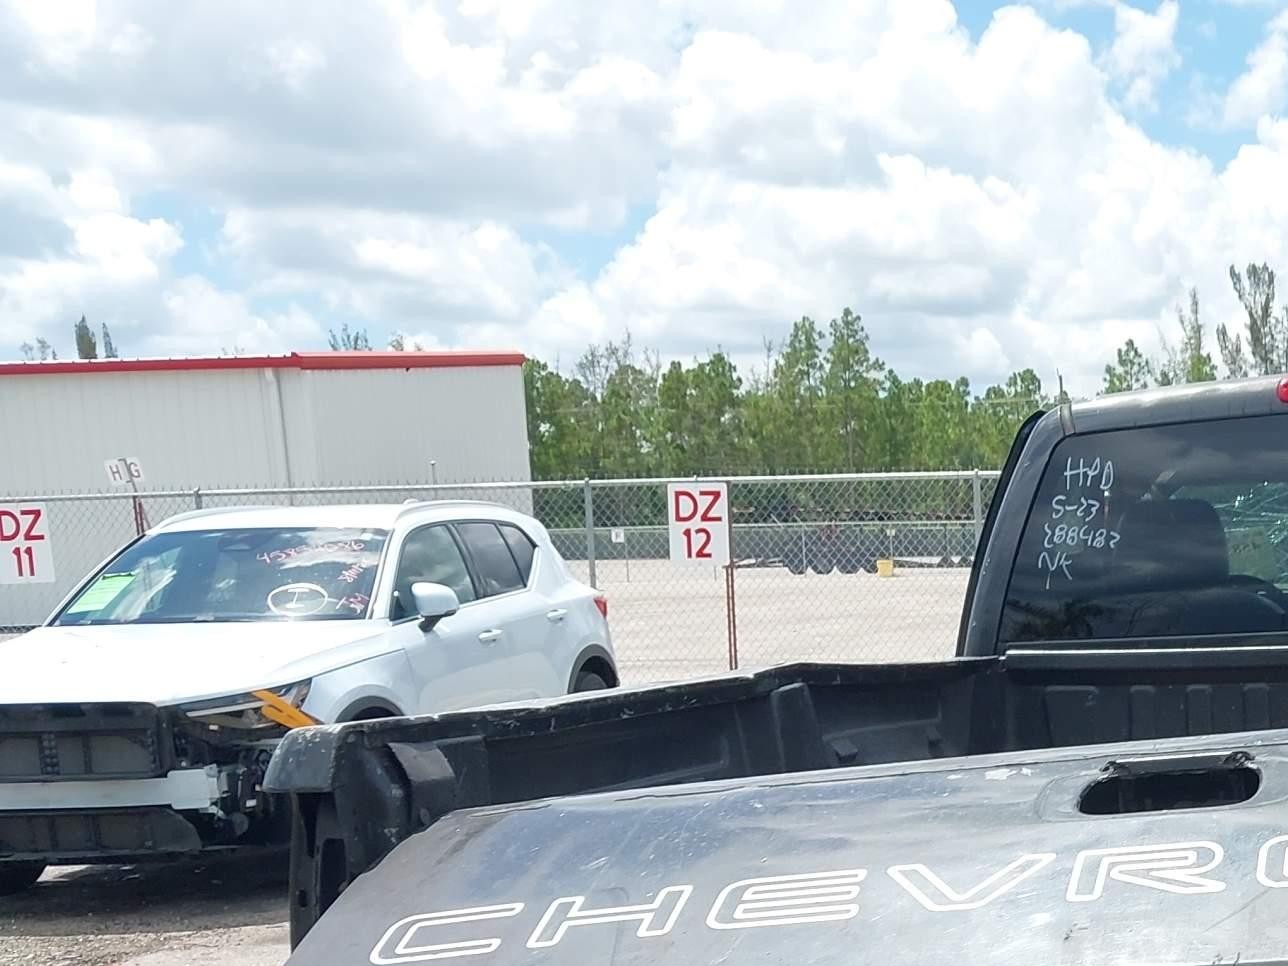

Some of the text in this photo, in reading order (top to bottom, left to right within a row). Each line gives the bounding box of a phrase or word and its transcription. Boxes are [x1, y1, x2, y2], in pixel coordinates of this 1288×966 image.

[109, 462, 141, 481] H G
[674, 490, 722, 522] DZ
[0, 509, 45, 541] DZ
[682, 528, 712, 558] 12
[12, 546, 35, 577] 11
